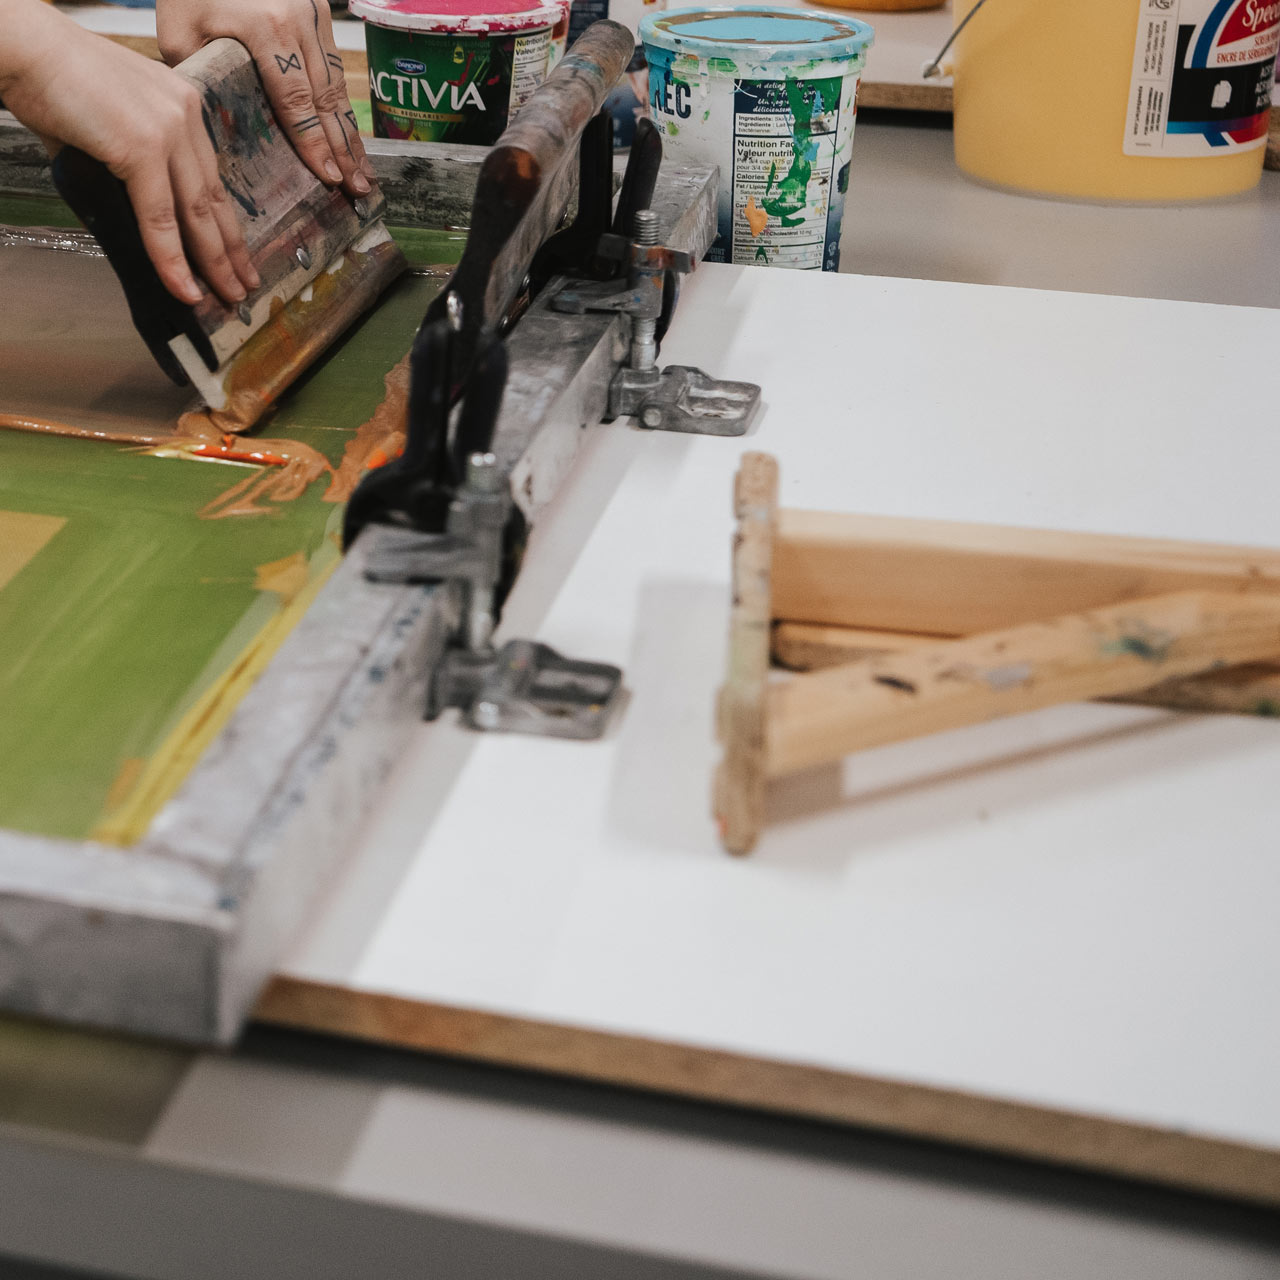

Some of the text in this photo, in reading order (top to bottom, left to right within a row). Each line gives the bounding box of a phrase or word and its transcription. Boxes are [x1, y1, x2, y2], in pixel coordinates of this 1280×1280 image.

[370, 66, 487, 111] ACTIVIA
[653, 80, 691, 119] REC
[737, 139, 794, 148] Nutrition Fac
[737, 148, 767, 157] Valeur
